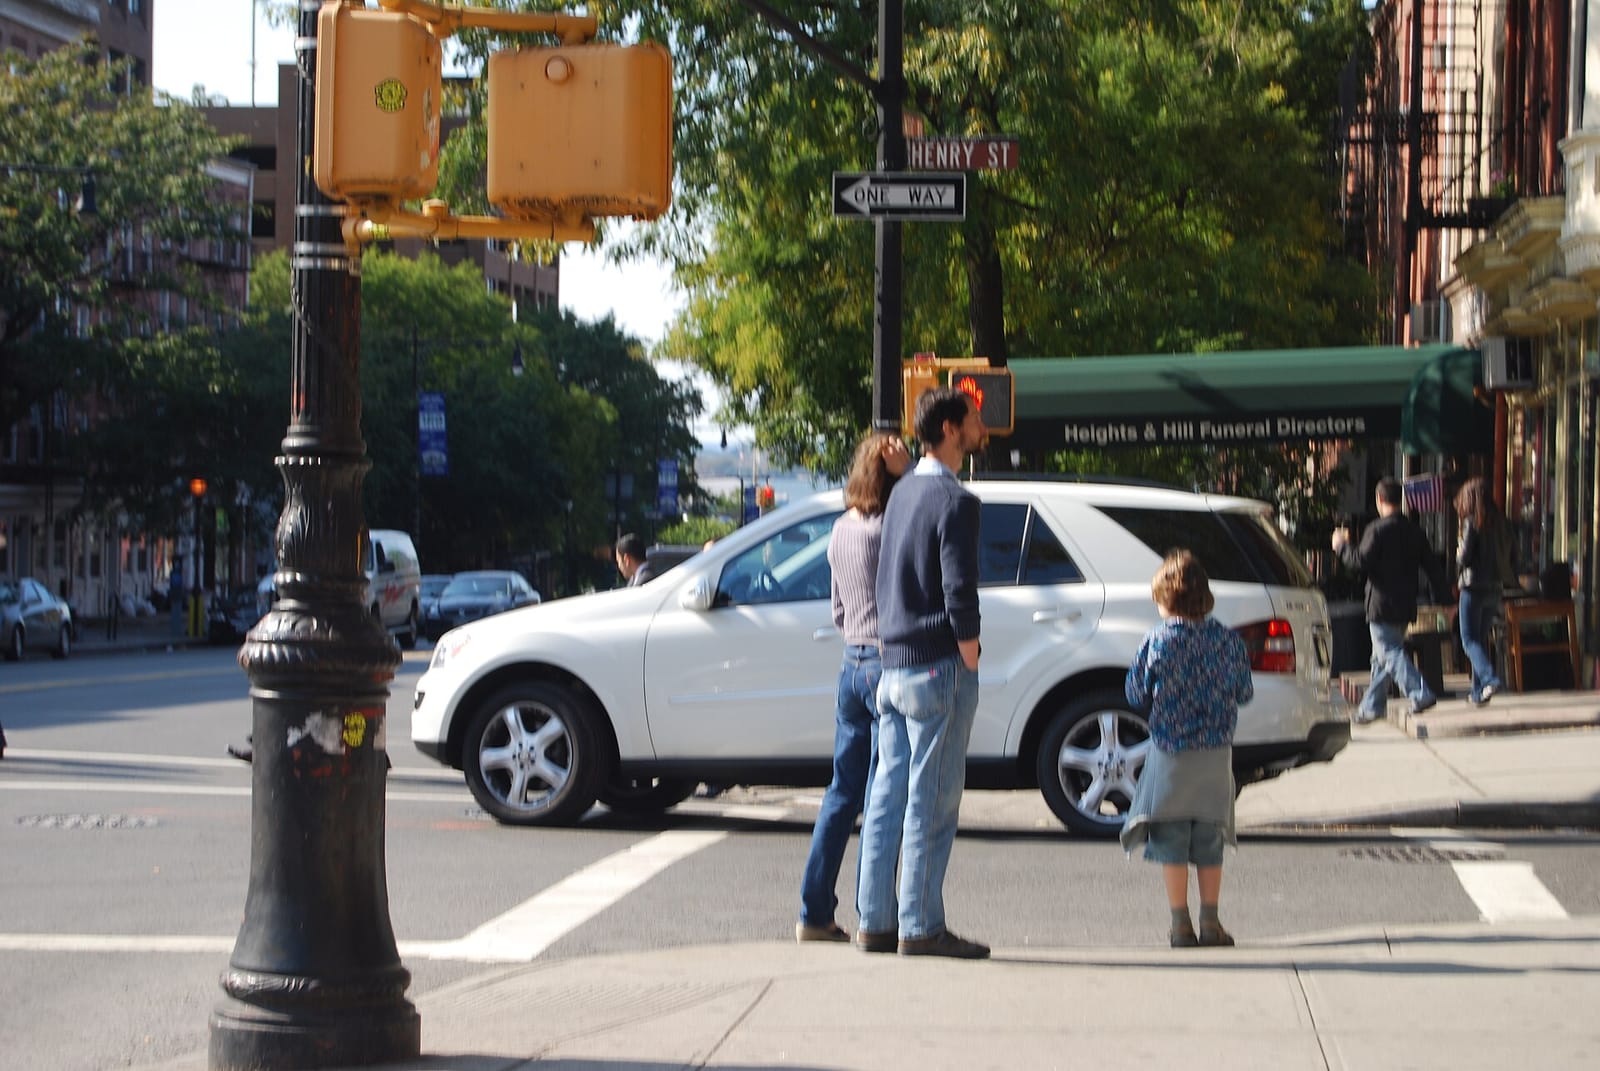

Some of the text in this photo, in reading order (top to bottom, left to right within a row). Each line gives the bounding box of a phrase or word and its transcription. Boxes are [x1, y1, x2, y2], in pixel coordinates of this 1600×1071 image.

[911, 141, 1010, 168] HENRY ST
[854, 185, 947, 206] ONE WAY
[1064, 415, 1366, 446] Heights & Hill Funeral Directors
